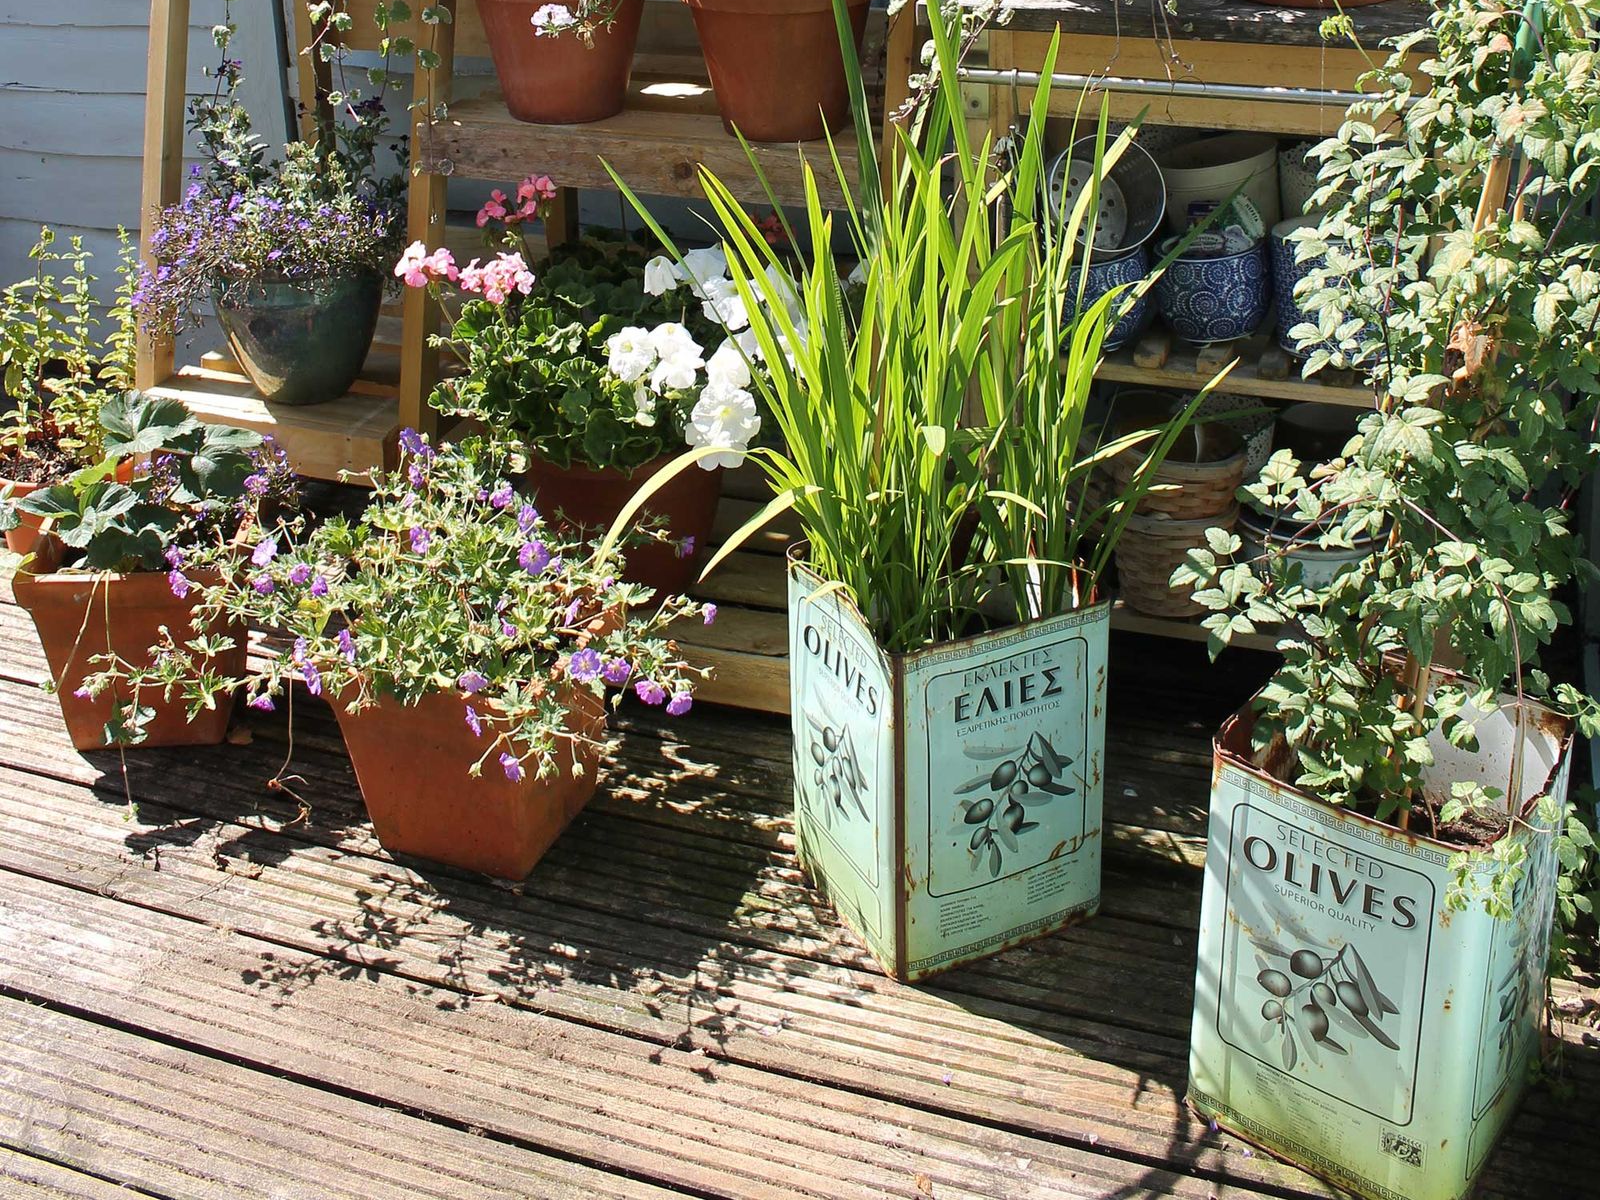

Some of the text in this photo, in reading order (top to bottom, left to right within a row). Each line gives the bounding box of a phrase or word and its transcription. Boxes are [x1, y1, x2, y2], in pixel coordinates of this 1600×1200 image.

[804, 625, 877, 716] OLIVES
[955, 666, 1062, 723] ΕΛΙΕΣ
[1277, 824, 1384, 879] SELECTED
[1243, 836, 1417, 928] OLIVES
[1274, 884, 1376, 932] SUPERIOR QUALITY
